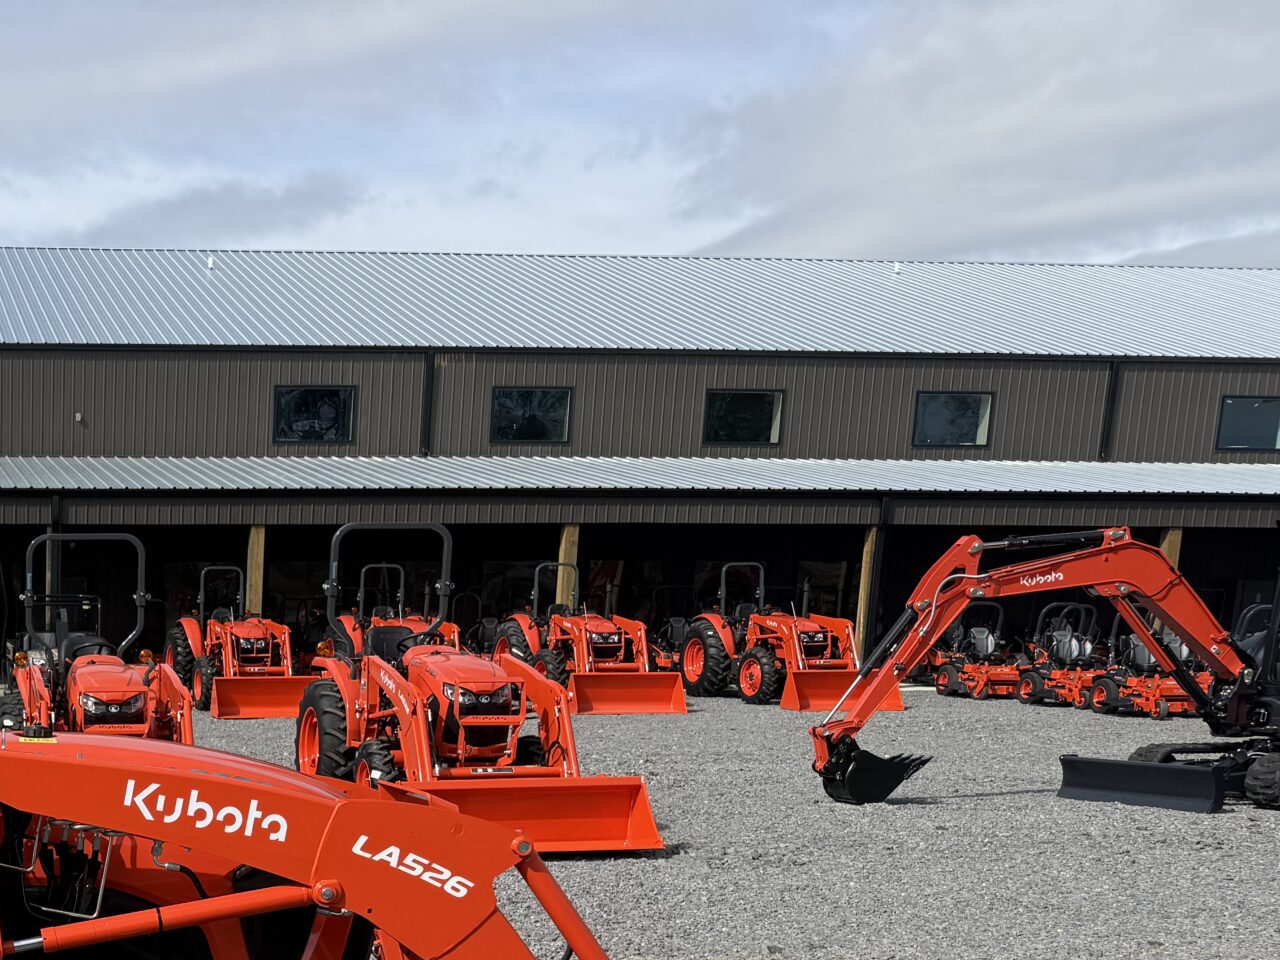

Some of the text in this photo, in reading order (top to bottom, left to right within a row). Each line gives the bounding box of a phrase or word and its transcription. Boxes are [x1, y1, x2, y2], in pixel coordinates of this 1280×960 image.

[1020, 571, 1064, 586] Kubota
[123, 779, 288, 843] Kubota
[351, 834, 475, 899] LA526
